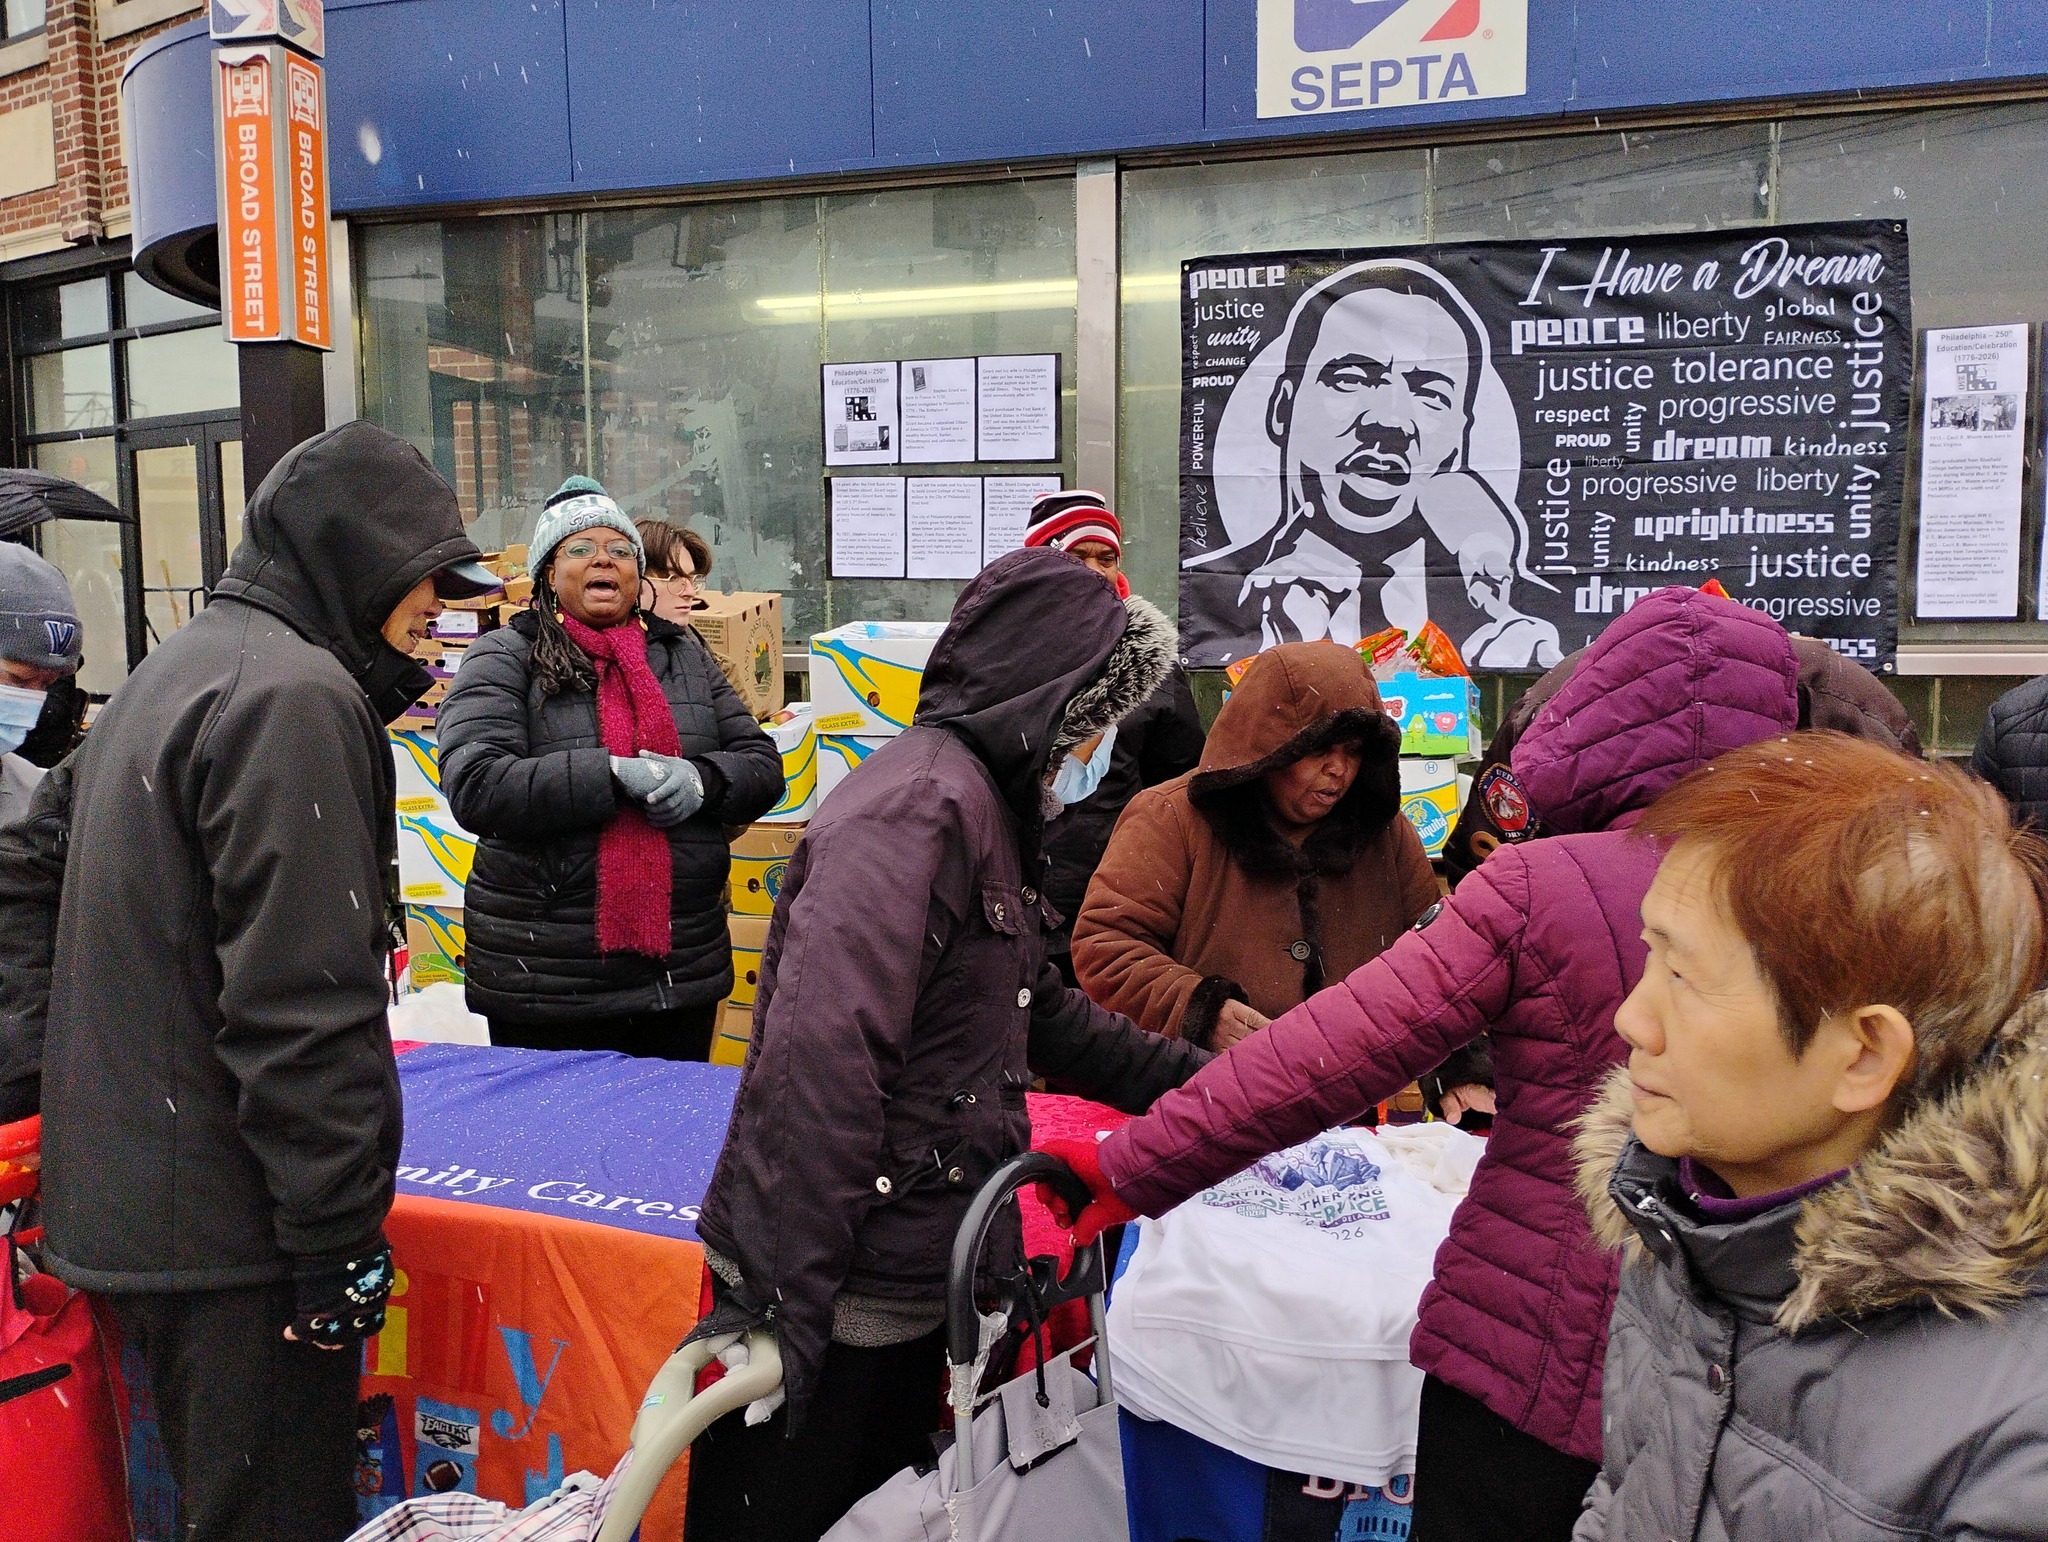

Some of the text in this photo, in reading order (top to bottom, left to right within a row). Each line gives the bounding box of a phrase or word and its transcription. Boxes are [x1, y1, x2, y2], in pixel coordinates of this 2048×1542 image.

[1290, 52, 1478, 111] SEPTA
[238, 124, 264, 332] BROAD STREET
[298, 130, 320, 340] BROAD STREET
[1189, 266, 1285, 299] peace
[1518, 237, 1885, 308] I Have a Dream
[1193, 297, 1264, 329] justice
[1765, 295, 1835, 322] global
[1207, 326, 1261, 351] unity
[1511, 311, 1750, 354] peace liberty
[1764, 331, 1840, 346] FAIRNESS
[1937, 342, 2017, 352] Education/Celebration
[1941, 332, 1986, 341] Philadelphia
[1206, 356, 1246, 366] CHANGE
[1534, 349, 1833, 400] justice tolerance
[1840, 291, 1890, 433] justice
[1954, 354, 2000, 362] (1776-2026)
[832, 377, 889, 386] Education/Celebration
[1192, 375, 1234, 388] PROUD
[1536, 406, 1610, 426] respect
[1659, 387, 1835, 424] progressive
[1193, 399, 1204, 469] POWERFUL
[1556, 434, 1611, 447] PROUD
[1623, 402, 1646, 452] unity
[1585, 455, 1623, 469] liberty
[1653, 430, 1771, 461] dream
[1785, 434, 1887, 456] kindness
[1583, 466, 1736, 501] progressive
[1757, 467, 1839, 496] liberty
[1187, 485, 1207, 548] believe
[1535, 458, 1577, 576] justice
[1844, 464, 1880, 538] unity
[1589, 512, 1615, 567] unity
[1635, 507, 1834, 543] uprightness
[1626, 551, 1719, 571] kindness
[1745, 545, 1871, 586] justice
[44, 620, 75, 656] V
[528, 1181, 702, 1221] Cares
[424, 1416, 472, 1442] EAGLES
